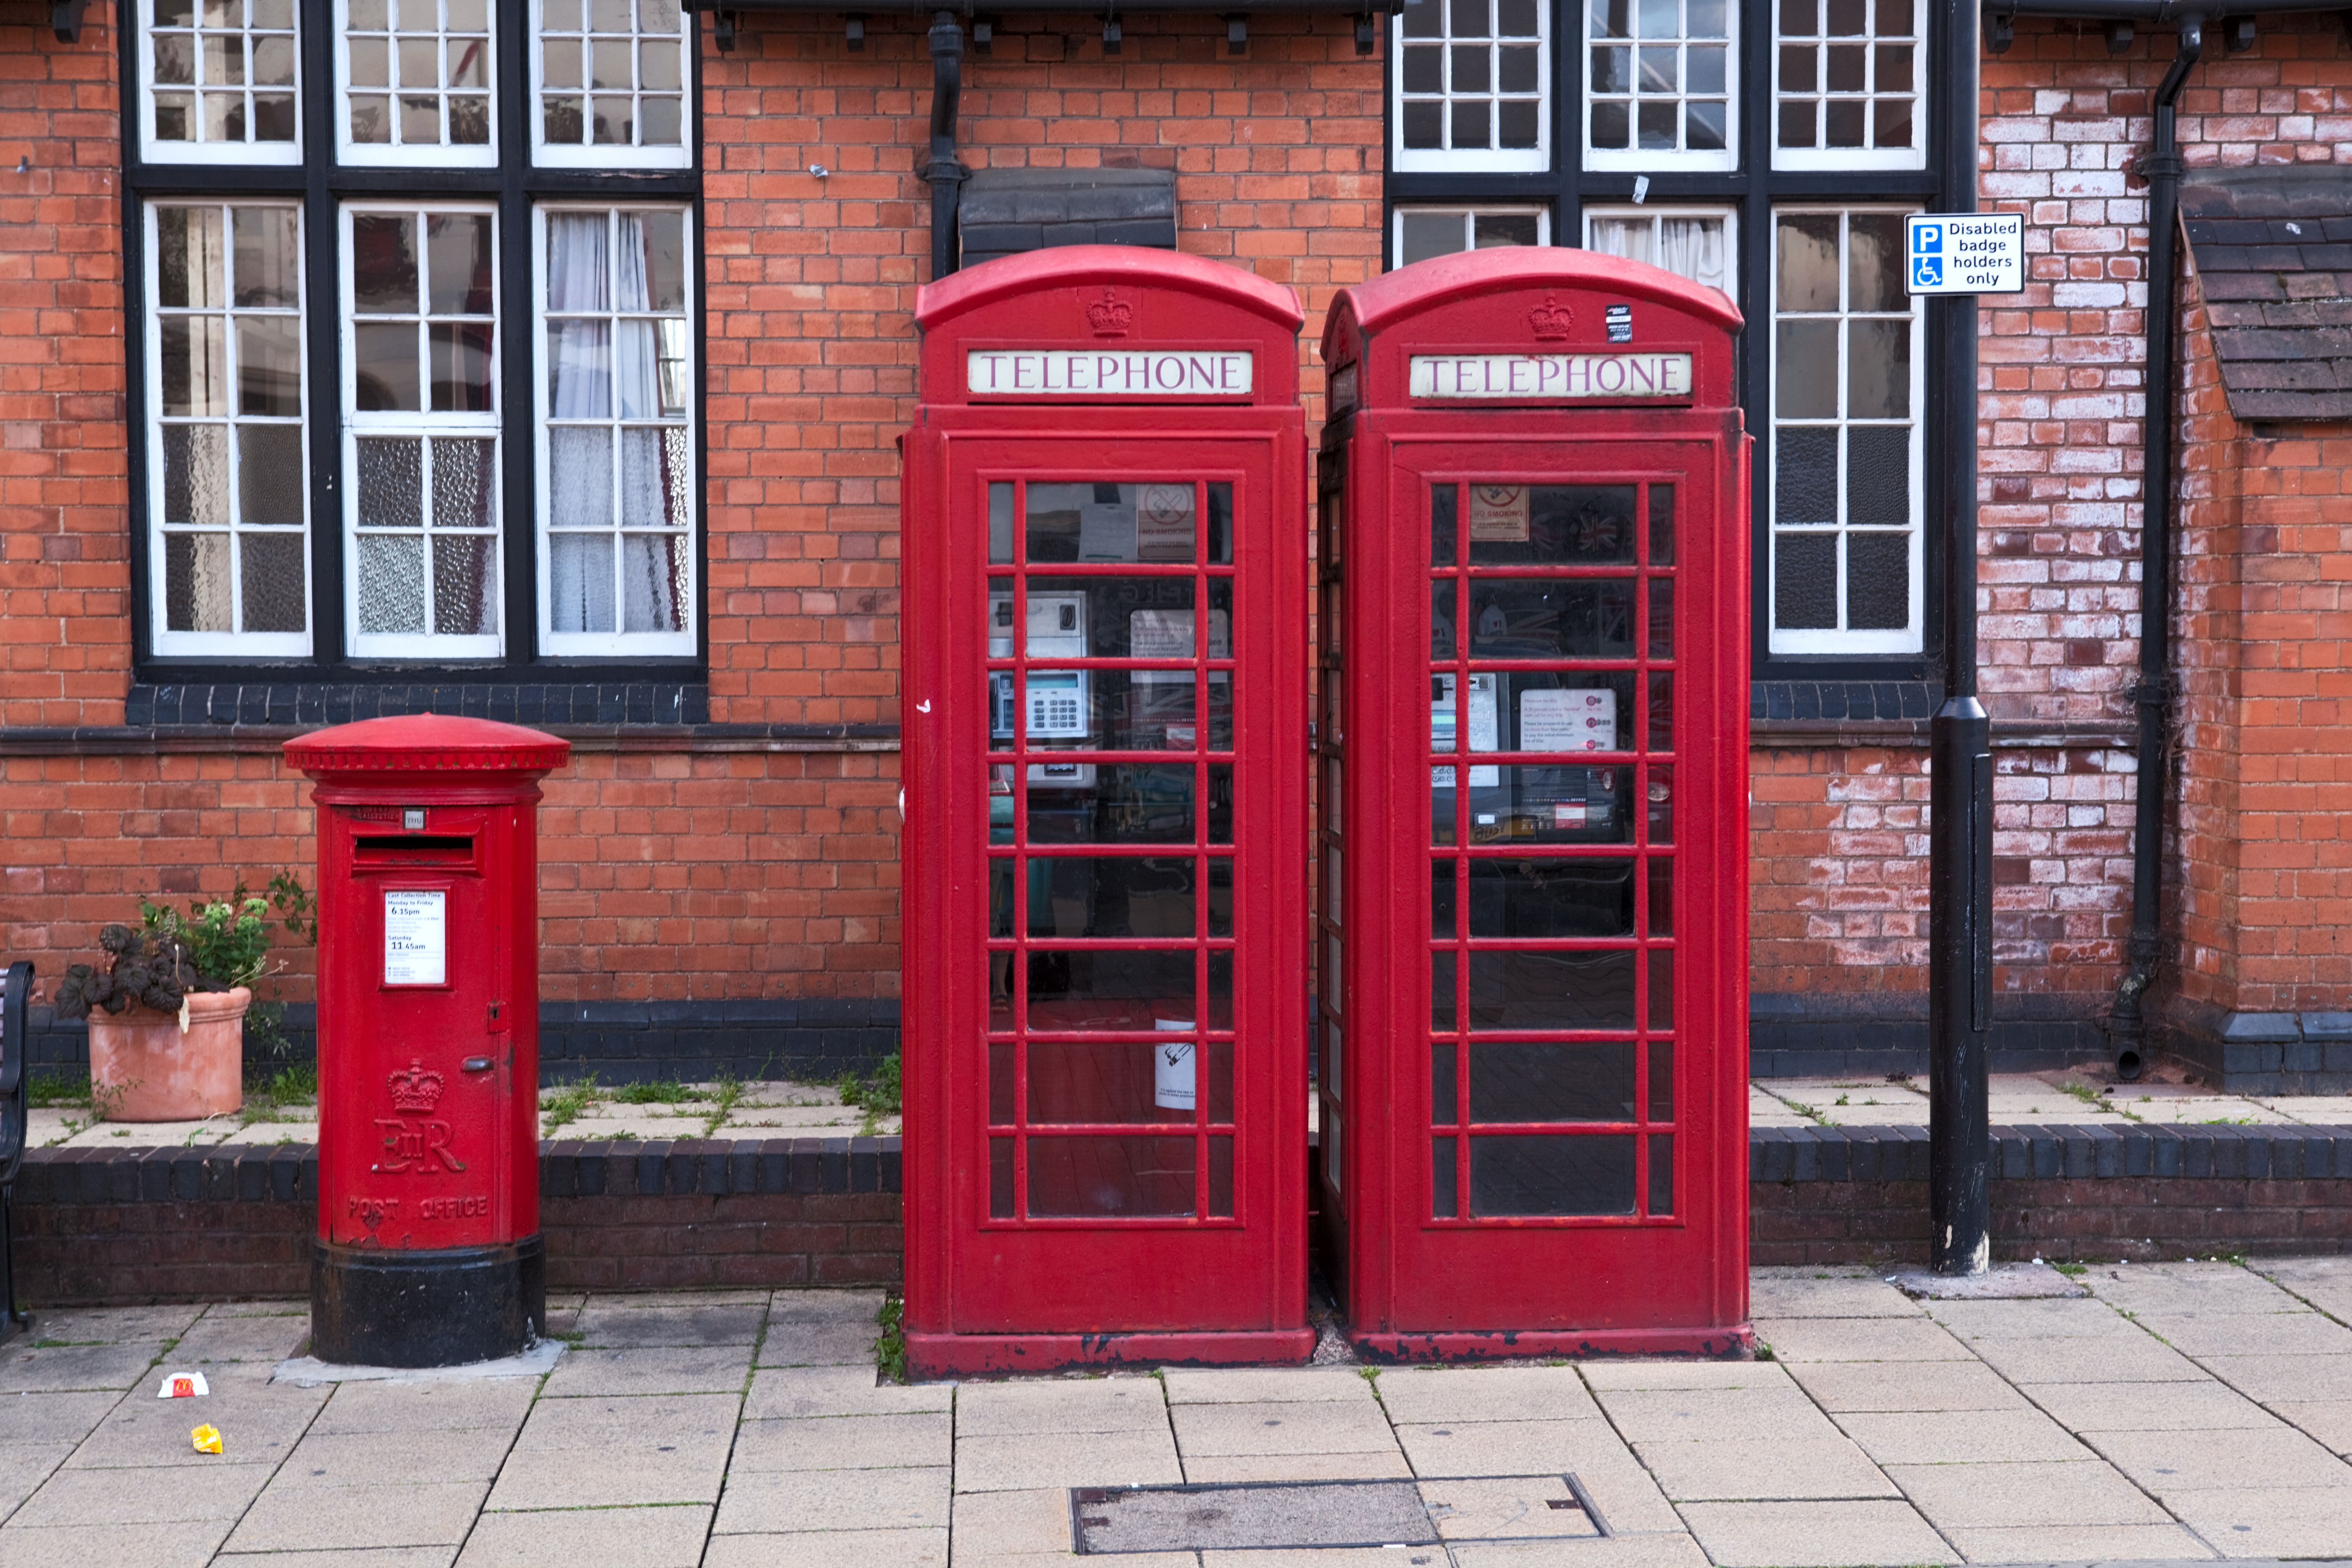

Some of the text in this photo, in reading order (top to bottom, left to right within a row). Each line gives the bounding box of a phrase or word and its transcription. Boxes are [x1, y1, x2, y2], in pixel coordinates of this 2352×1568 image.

[1950, 222, 2017, 235] Disabled
[1920, 227, 1938, 251] P
[1960, 240, 2006, 253] badge
[1954, 256, 2012, 268] holders
[1967, 273, 1999, 286] only
[980, 356, 1240, 389] TELEPHONE
[1422, 358, 1681, 392] TELEPHONE
[392, 907, 420, 916] 6.15pm
[349, 1196, 487, 1219] POST OFFICE
